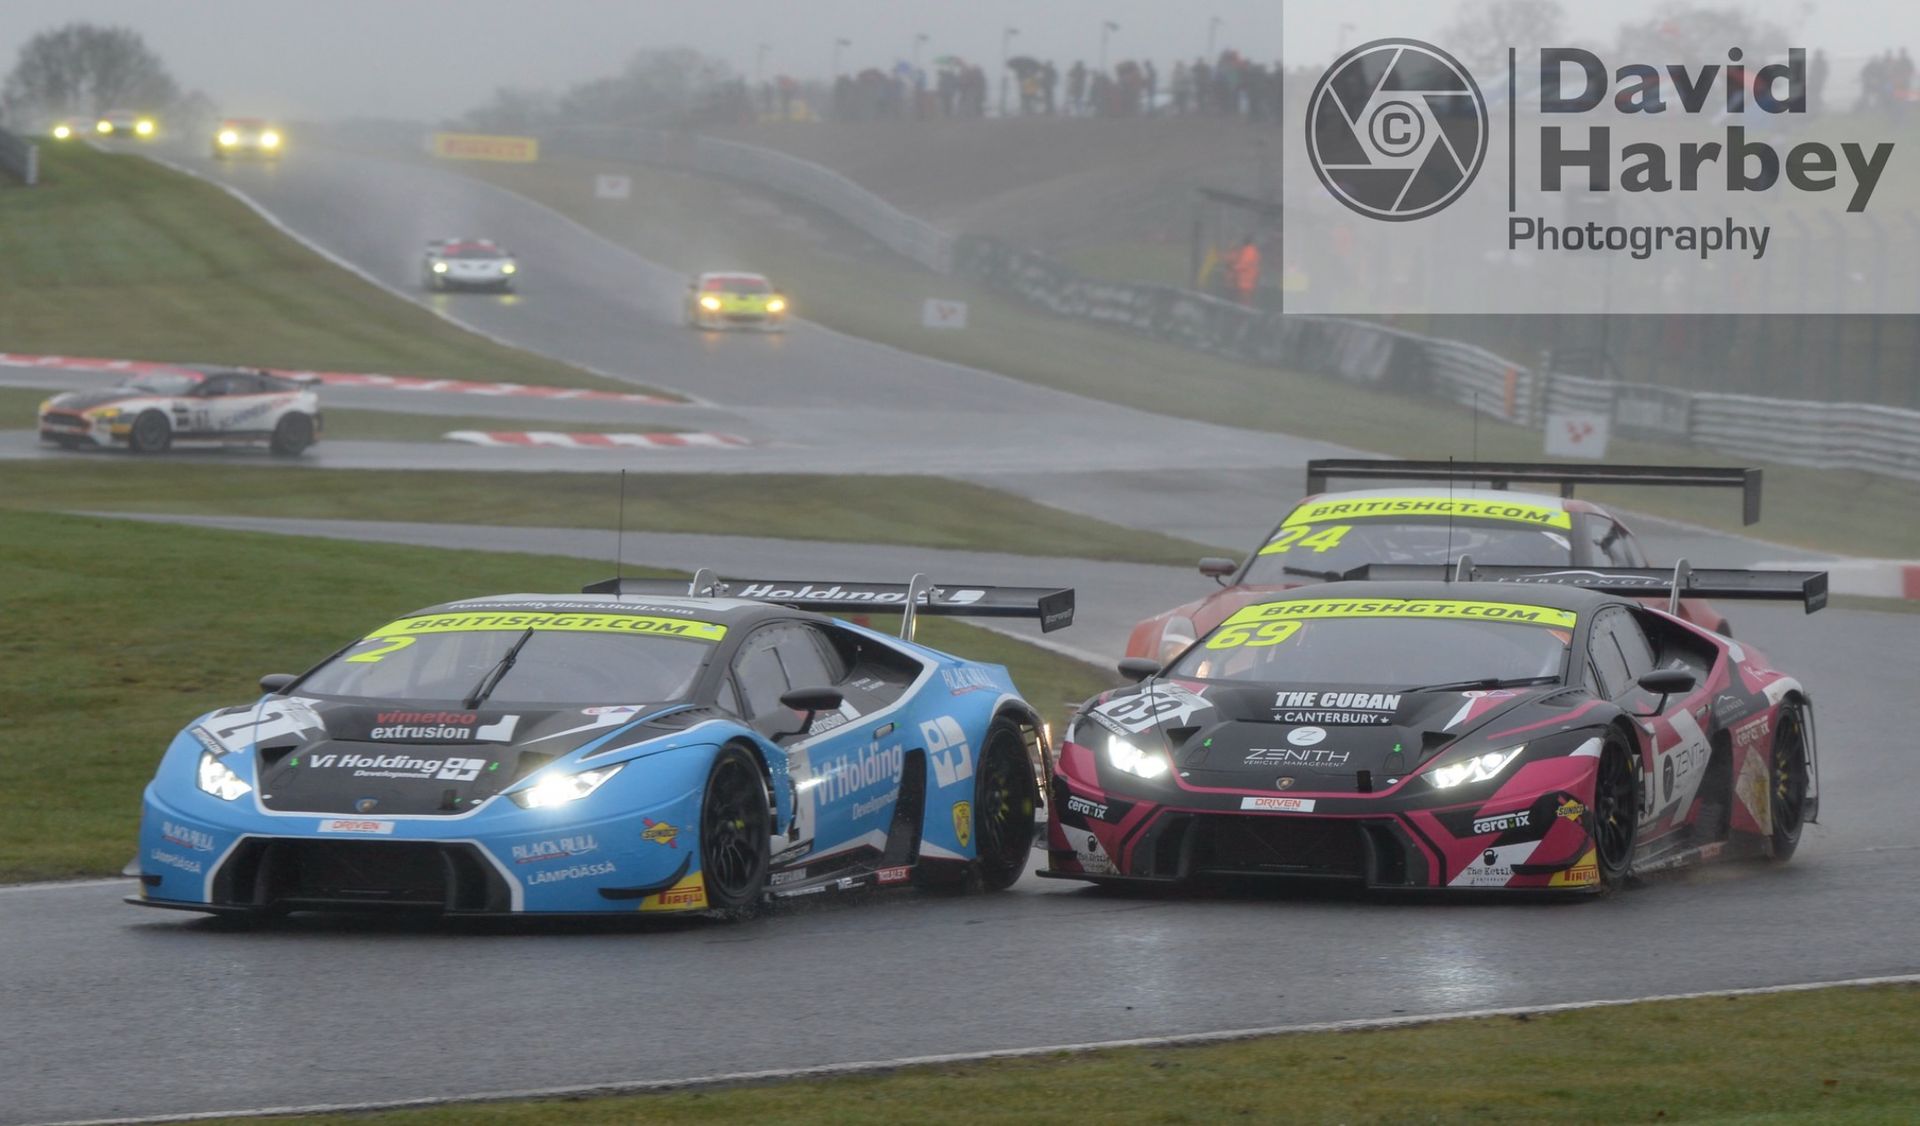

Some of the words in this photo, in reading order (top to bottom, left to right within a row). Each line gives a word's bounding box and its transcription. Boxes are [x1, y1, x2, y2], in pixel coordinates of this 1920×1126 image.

[1310, 500, 1552, 523] BRITISHGT.COM
[1258, 525, 1353, 556] 24
[1260, 600, 1542, 623] BRITISHGT.COM
[405, 613, 690, 636] BRITISHGT.COM
[1205, 620, 1302, 650] 69
[345, 636, 416, 662] 2
[1275, 691, 1319, 707] THE
[1320, 692, 1402, 710] CUBAN
[376, 710, 478, 725] vimetco
[1284, 712, 1379, 724] CANTERBURY
[370, 724, 471, 740] extrusion
[309, 754, 337, 769] Vi
[337, 755, 442, 773] Holding
[1245, 748, 1351, 762] ZENITH
[353, 769, 432, 780] Development
[836, 741, 903, 798] Holding
[1254, 798, 1302, 808] DRIVEN
[1557, 805, 1584, 817] SUNOCO
[332, 820, 379, 831] DRIVEN
[512, 840, 561, 859] BLACK
[559, 835, 599, 853] BULL
[1467, 866, 1483, 876] The
